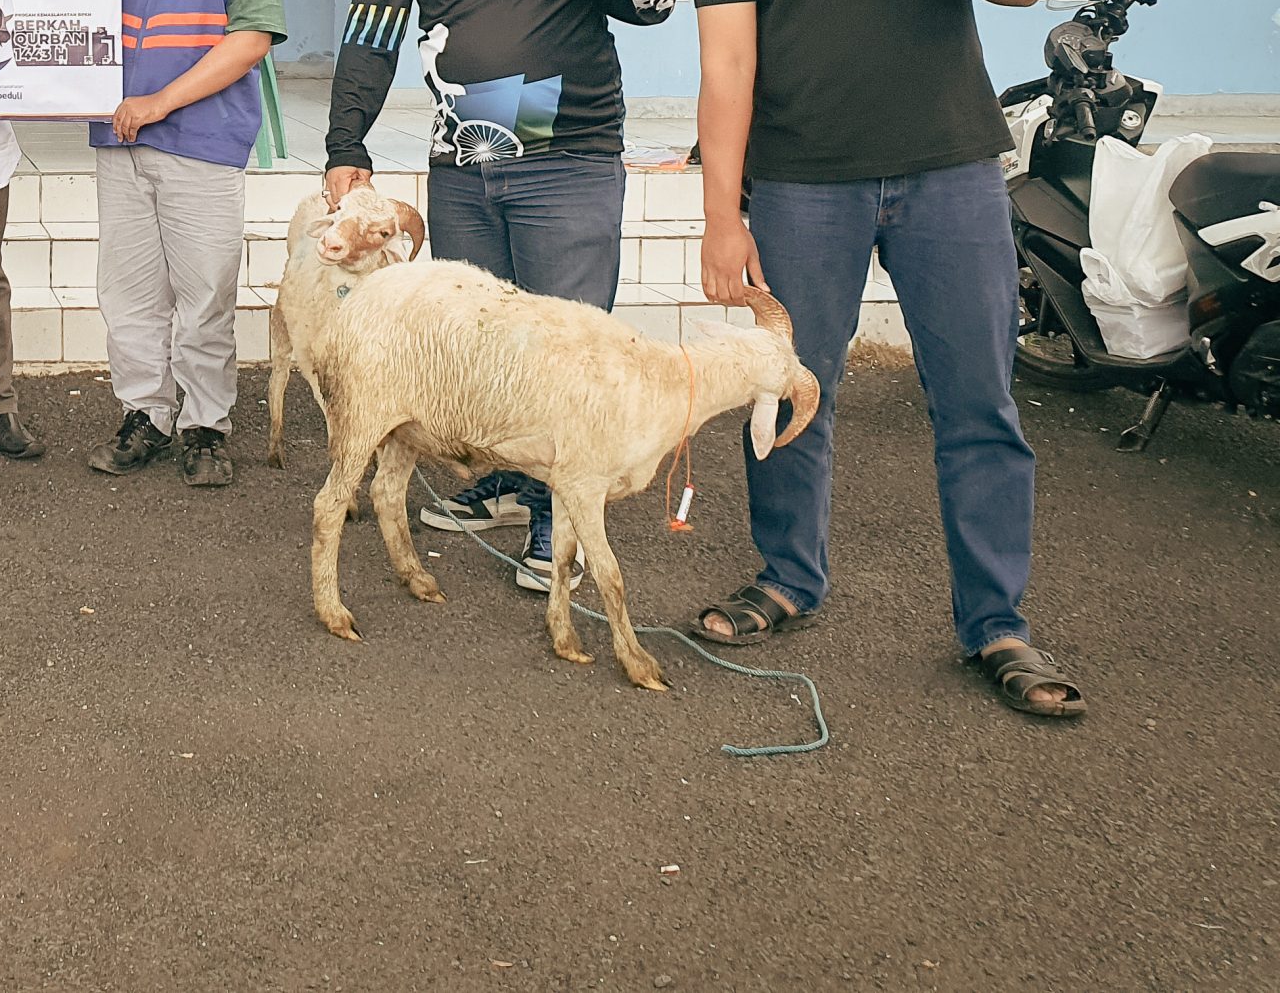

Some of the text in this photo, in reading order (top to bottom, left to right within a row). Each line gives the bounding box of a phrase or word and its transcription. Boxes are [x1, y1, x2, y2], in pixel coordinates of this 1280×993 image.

[14, 19, 81, 31] BERKAH
[14, 33, 85, 46] QURBAN
[14, 48, 67, 60] 1443 H
